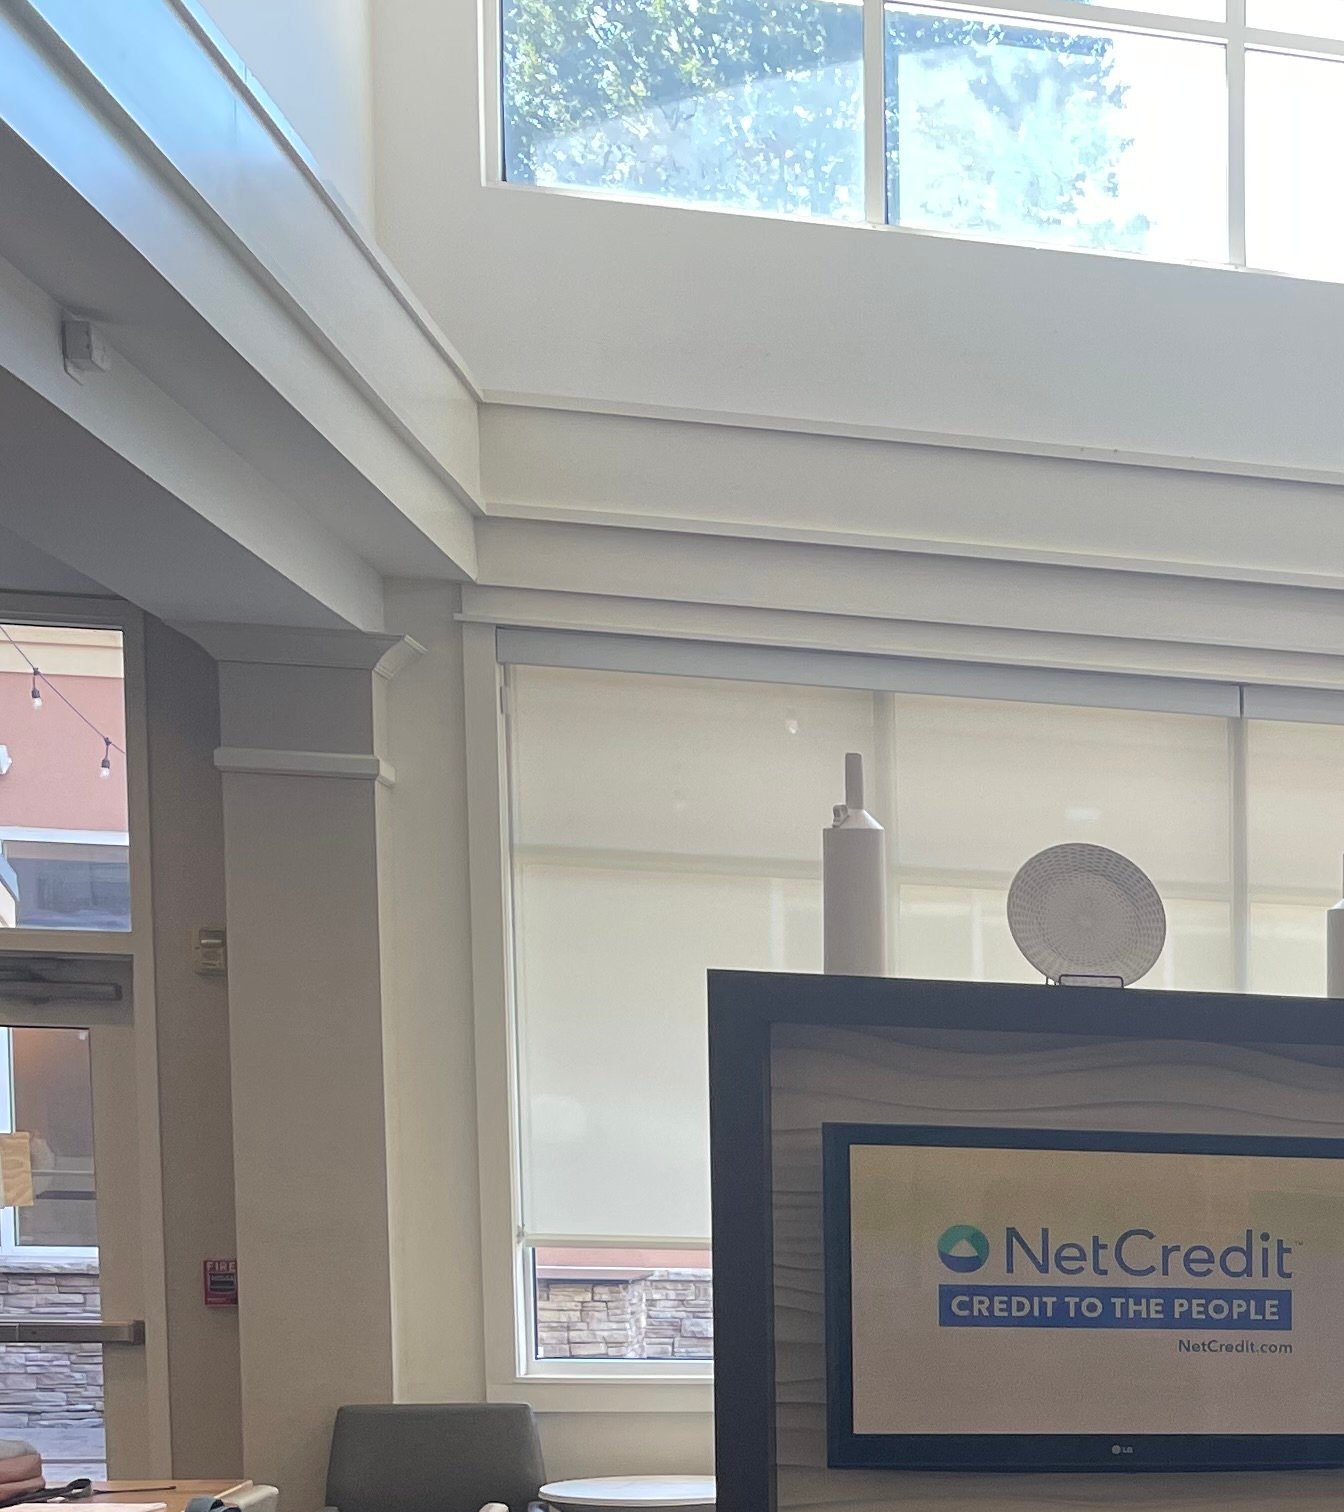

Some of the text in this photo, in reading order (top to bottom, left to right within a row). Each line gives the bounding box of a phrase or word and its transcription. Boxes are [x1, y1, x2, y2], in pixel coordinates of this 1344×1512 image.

[1005, 1227, 1293, 1279] NetCredit
[206, 1261, 236, 1273] FIRE
[950, 1295, 1280, 1320] CREDIT TO THE PEOPLE
[1178, 1339, 1293, 1354] NetCredit.com
